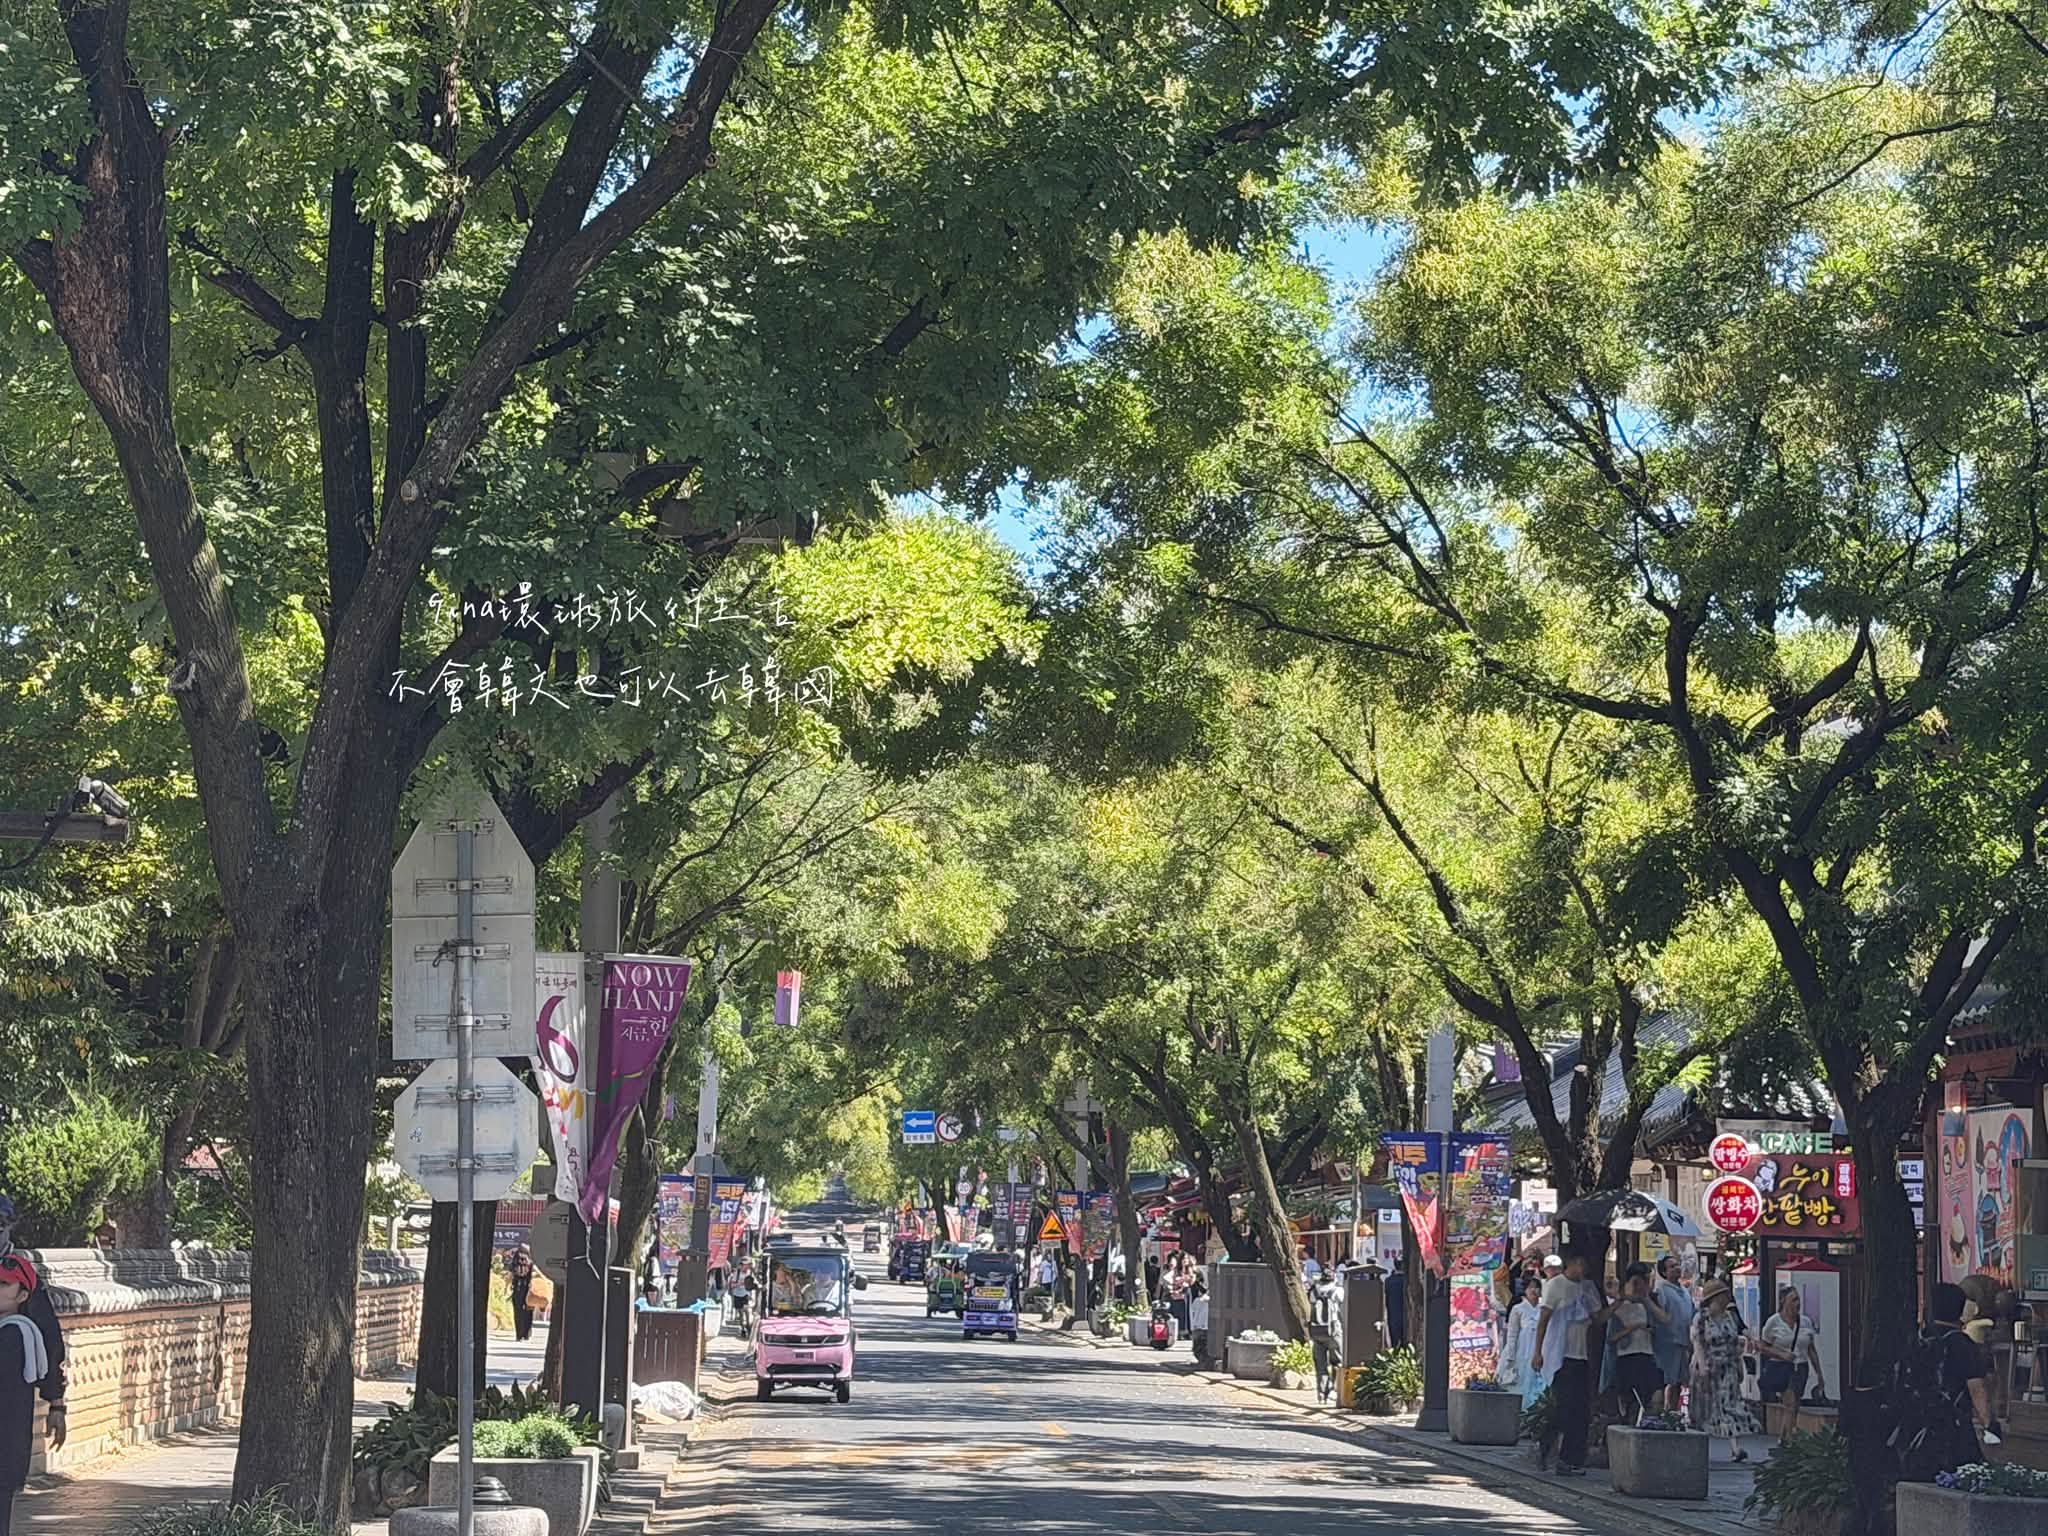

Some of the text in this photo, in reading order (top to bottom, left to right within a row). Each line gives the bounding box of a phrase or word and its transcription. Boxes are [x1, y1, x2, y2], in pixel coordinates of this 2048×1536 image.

[612, 964, 684, 988] NOW
[602, 988, 685, 1012] HANJ
[1760, 1132, 1832, 1153] CAFE
[1779, 1163, 1830, 1192] 누이
[1710, 1195, 1758, 1216] 쌍화차
